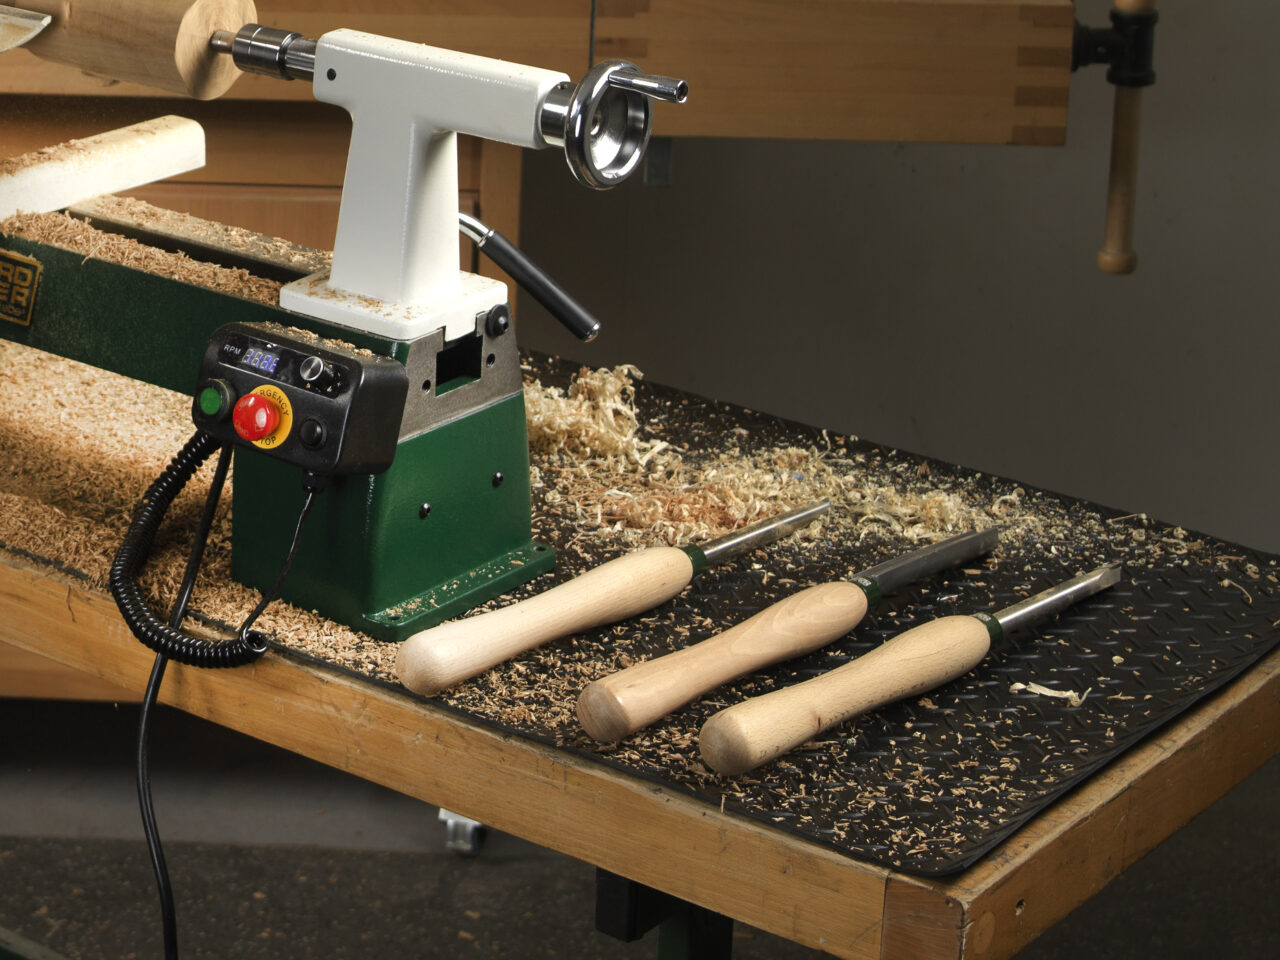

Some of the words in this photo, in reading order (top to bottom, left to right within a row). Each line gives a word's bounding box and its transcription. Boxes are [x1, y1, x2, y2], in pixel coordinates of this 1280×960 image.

[223, 344, 241, 355] RPM
[257, 389, 290, 416] RGENCY
[260, 436, 277, 446] TOP
